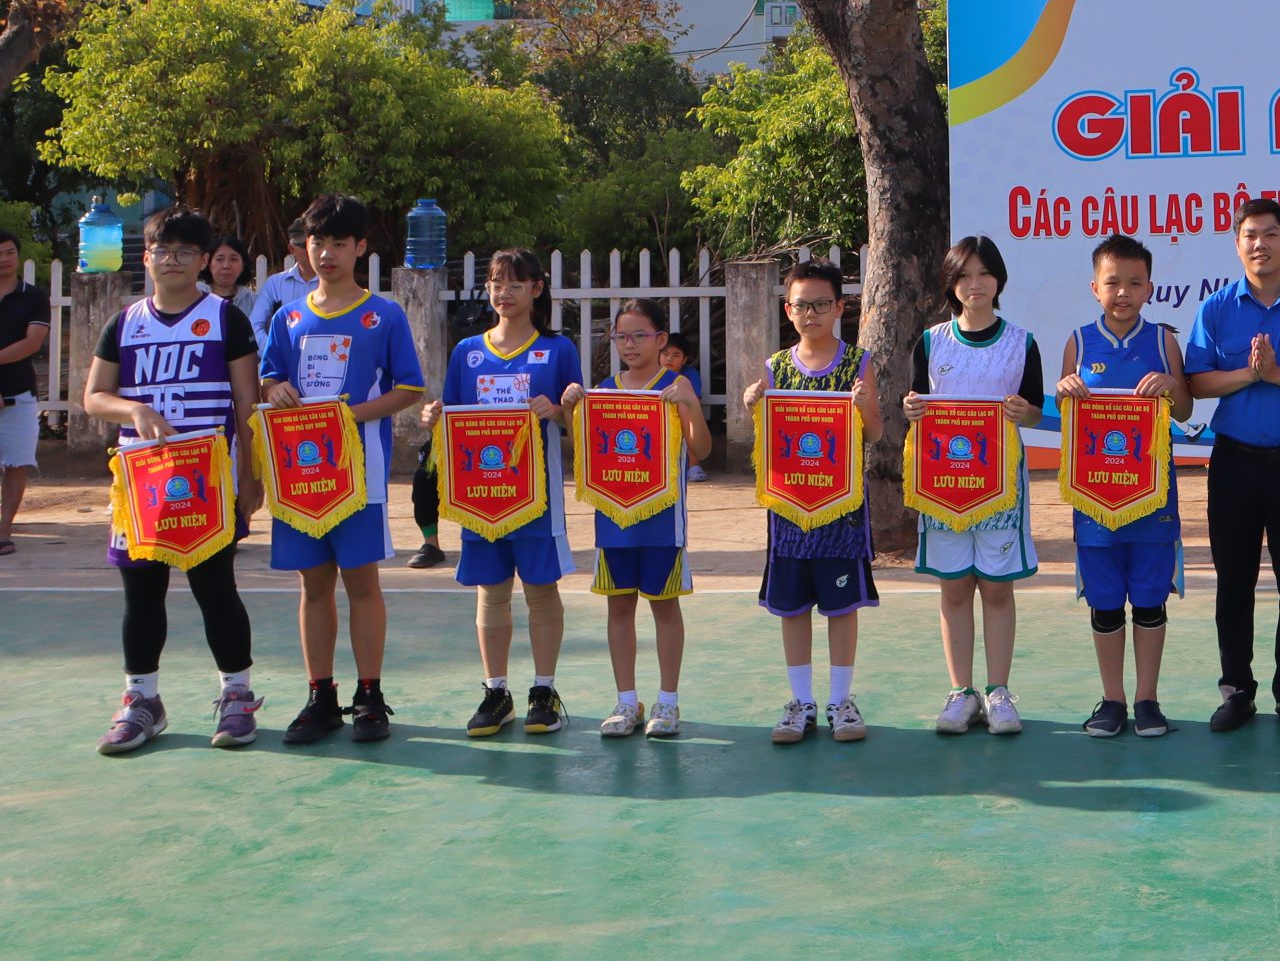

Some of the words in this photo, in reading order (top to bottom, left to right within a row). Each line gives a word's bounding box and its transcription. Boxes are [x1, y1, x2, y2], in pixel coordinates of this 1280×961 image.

[1053, 68, 1245, 160] GIẢI
[1008, 186, 1071, 238] CÁC
[1081, 187, 1138, 236] CÂU
[1149, 192, 1202, 243] LẠC
[1146, 282, 1190, 308] uy
[134, 343, 204, 384] NDC
[301, 467, 319, 475] 2024
[603, 469, 622, 481] LƯU
[624, 468, 649, 485] NIỆM
[1088, 471, 1109, 483] LƯU
[1112, 470, 1138, 487] NIỆM
[291, 482, 309, 495] LƯU
[311, 477, 336, 495] NIỆM
[784, 473, 805, 484] LƯU
[808, 472, 833, 489] NIỆM
[934, 475, 955, 487] LƯU
[958, 474, 985, 491] NIỆM
[467, 485, 488, 497] LƯU
[491, 482, 516, 500] NIỆM
[170, 501, 191, 510] 2024
[155, 517, 178, 532] LƯU
[181, 512, 207, 529] NIỆM
